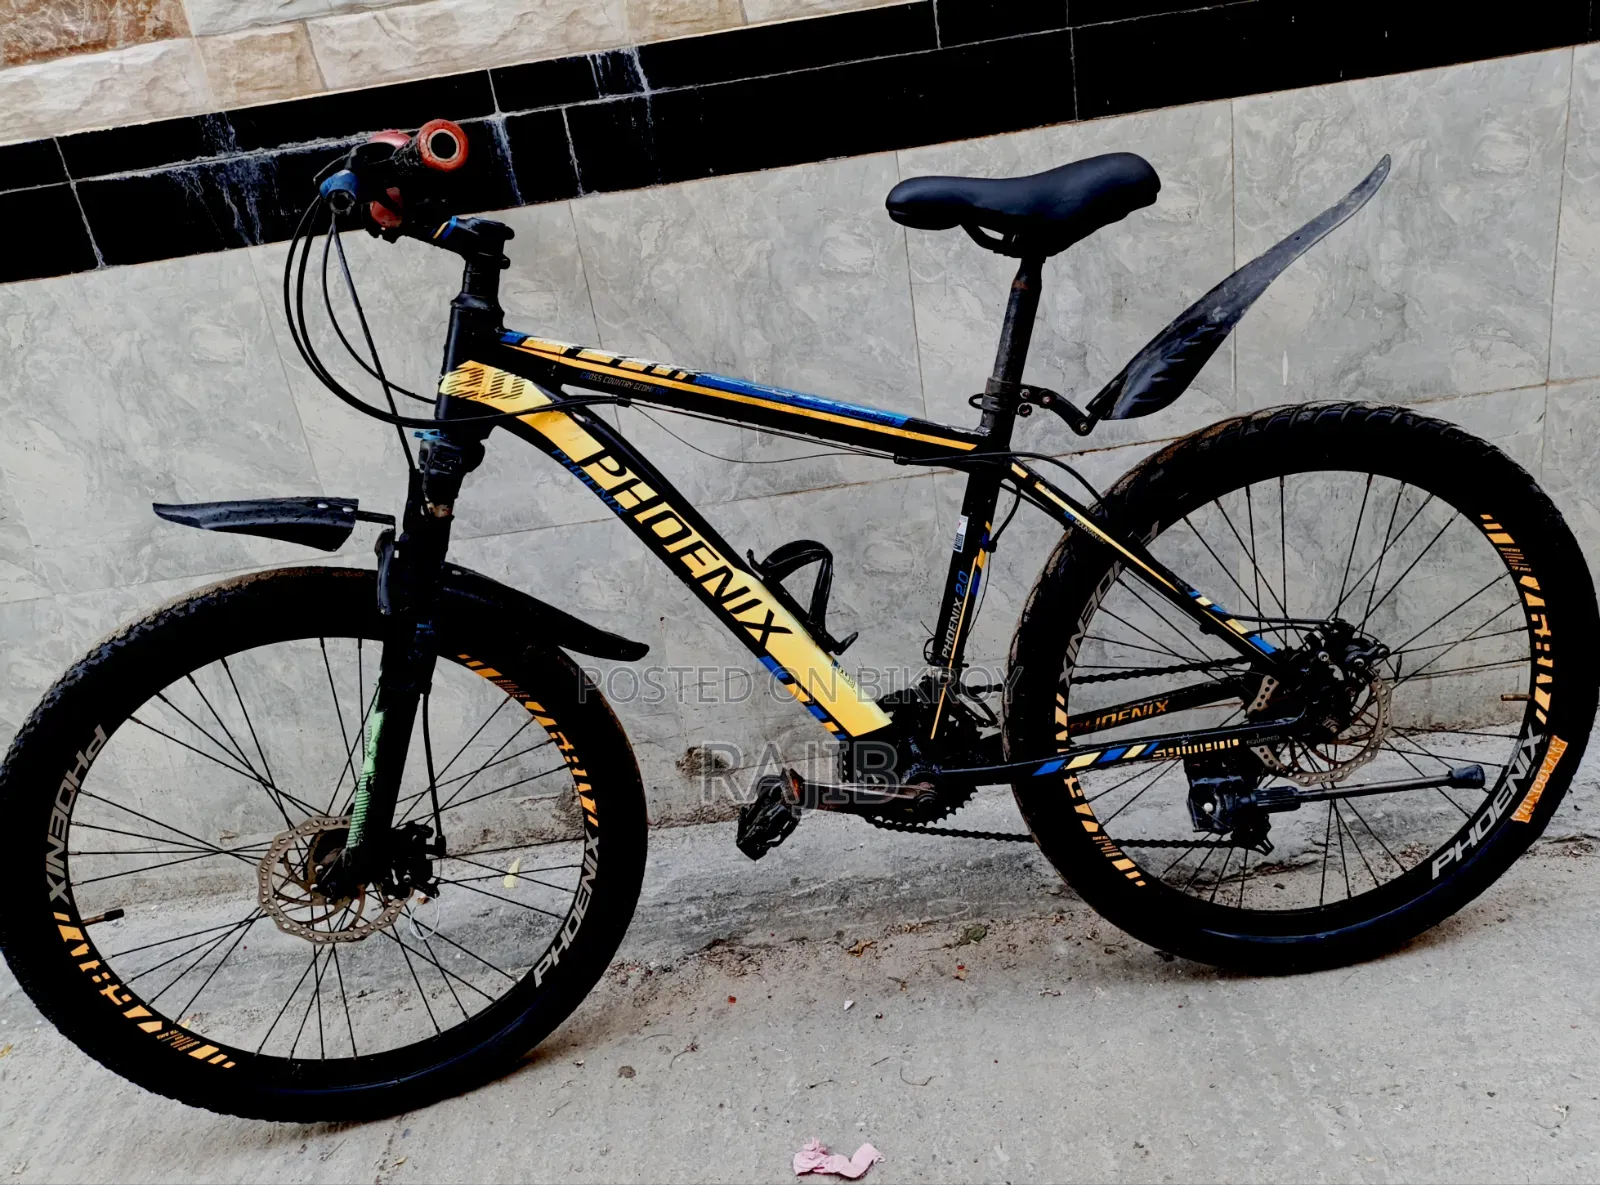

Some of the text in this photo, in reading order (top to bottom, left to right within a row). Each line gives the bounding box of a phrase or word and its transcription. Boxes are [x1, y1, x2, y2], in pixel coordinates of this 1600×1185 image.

[580, 371, 604, 382] CROSS
[603, 376, 633, 389] COUNTRY
[551, 449, 627, 515] PHOENIX
[575, 450, 794, 648] PHOENIX
[941, 597, 963, 659] PHOENIX
[955, 570, 969, 598] 2.0
[1246, 735, 1280, 745] EQUIPPED
[1510, 735, 1568, 823] ANACONDA
[46, 724, 107, 906] PHOENIX
[1431, 723, 1542, 880] PHOENIX
[533, 828, 600, 988] PHOENIX
